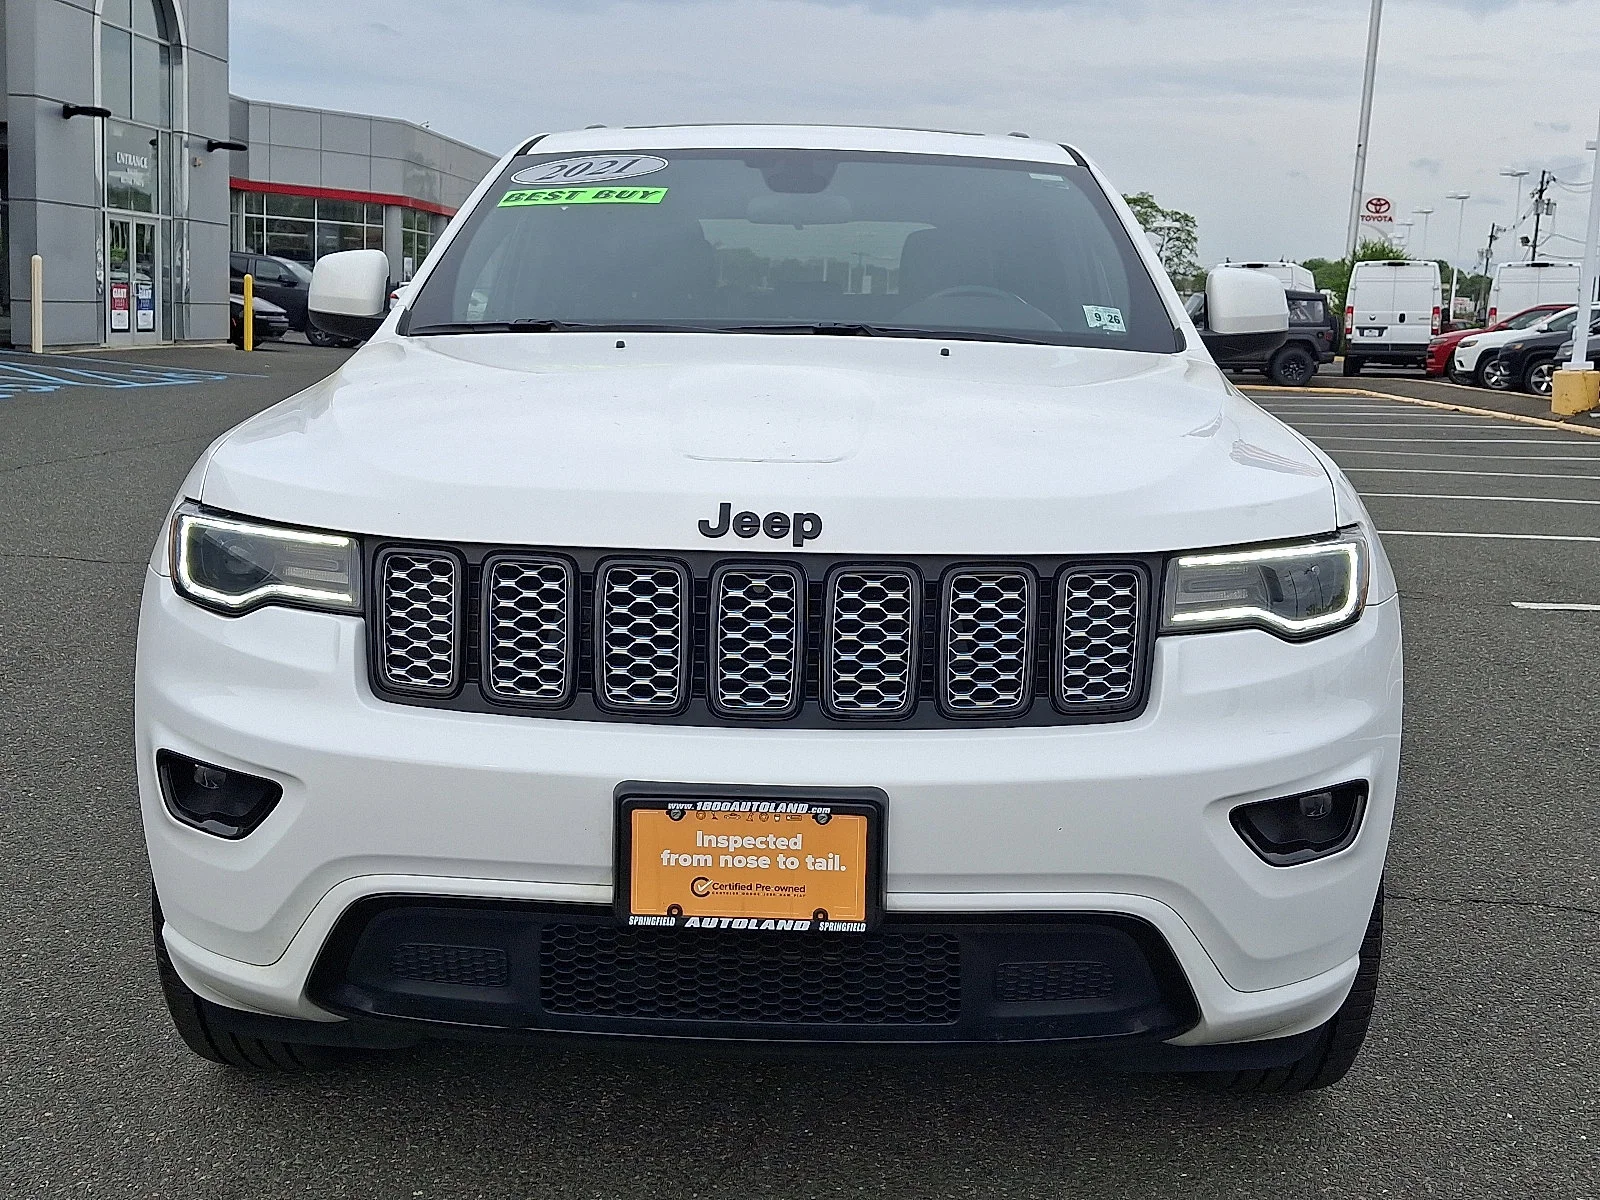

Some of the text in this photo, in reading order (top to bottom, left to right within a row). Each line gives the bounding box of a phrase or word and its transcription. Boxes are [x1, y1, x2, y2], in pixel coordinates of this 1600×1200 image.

[116, 151, 148, 169] ENTRANCE
[535, 158, 642, 181] 2021
[503, 189, 662, 203] BEST BUY
[1360, 215, 1393, 223] TOYOTA
[1094, 312, 1121, 325] 9 26
[698, 502, 823, 547] Jeep
[696, 830, 803, 851] Inspected
[660, 850, 847, 872] from nose to tail.
[711, 882, 806, 893] Certified Pre-owned
[628, 915, 867, 933] SPRINGFIELD AUTOLAND SPRINGFIELD
